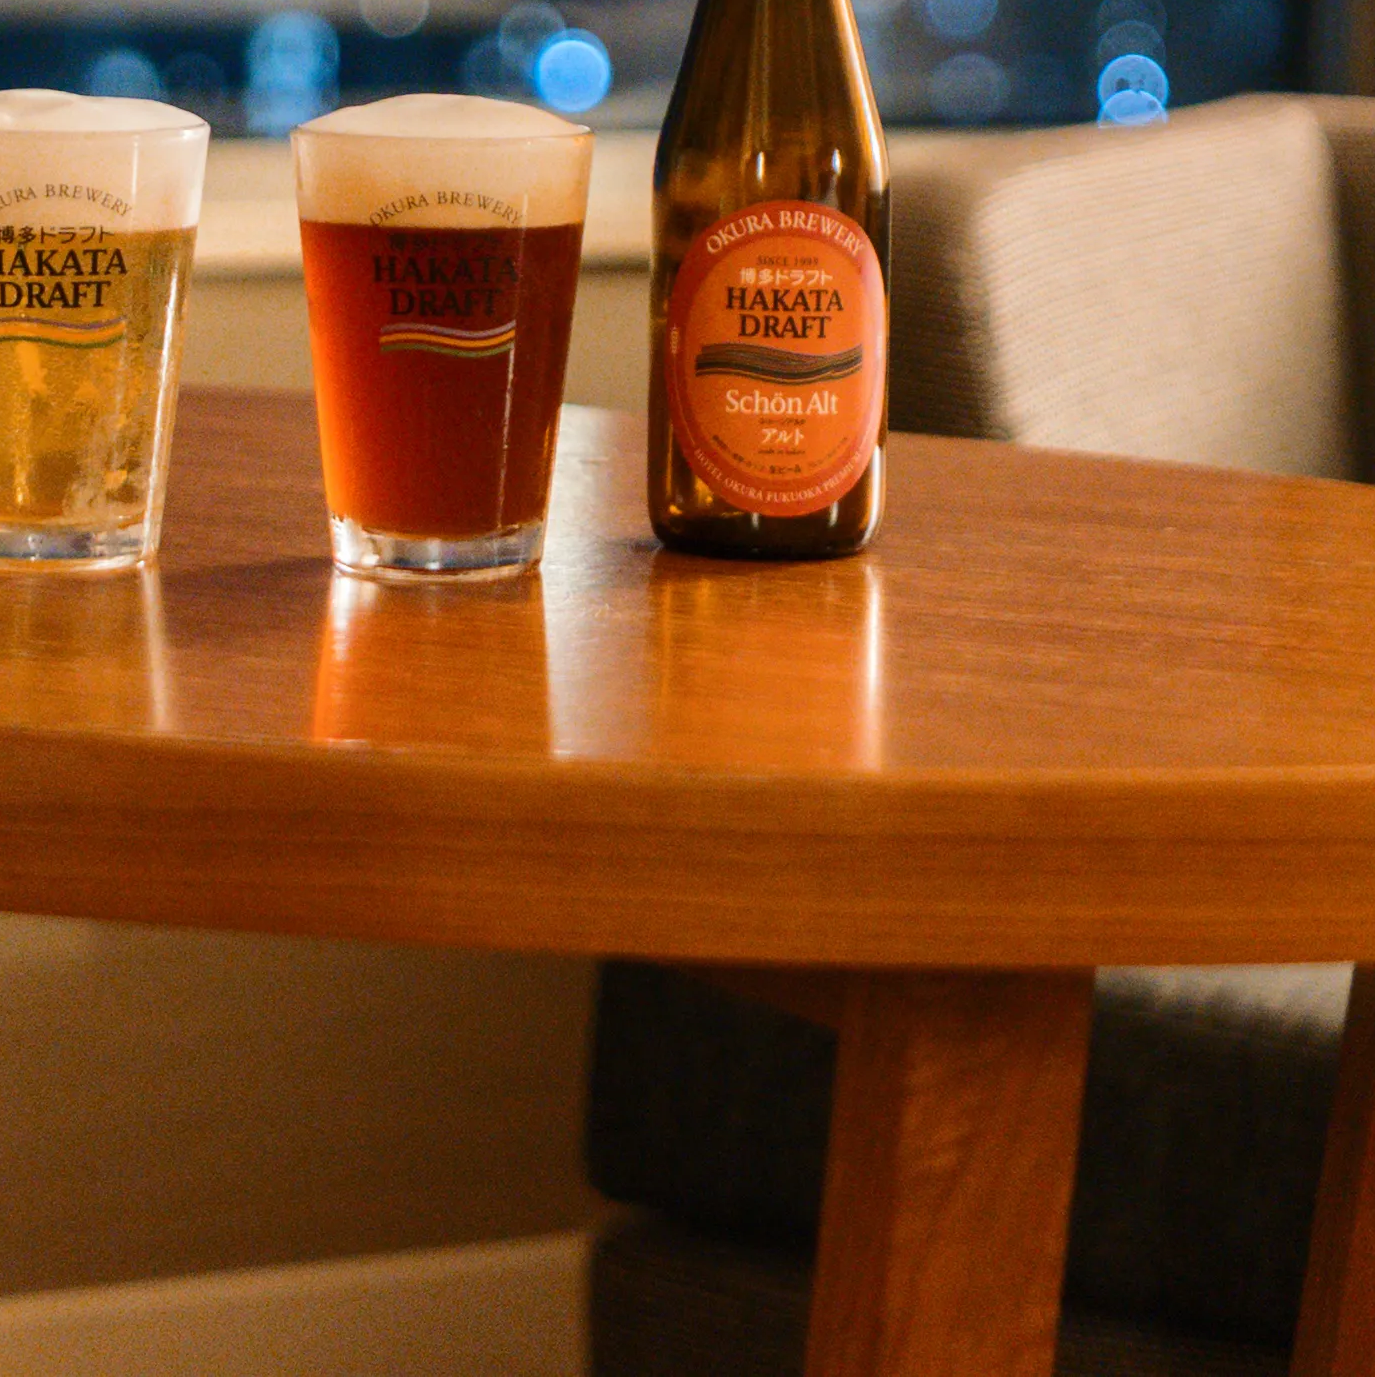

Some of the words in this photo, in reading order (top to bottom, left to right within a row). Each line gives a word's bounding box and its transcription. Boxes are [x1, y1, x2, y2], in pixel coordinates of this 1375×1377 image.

[45, 183, 132, 217] BREWERY
[370, 194, 430, 225] OKURA
[437, 191, 523, 225] BREWERY
[706, 212, 774, 254] OKURA
[779, 210, 864, 257] BREWERY
[373, 256, 519, 284] HAKATA
[740, 267, 833, 286] 博多ドラフト
[388, 288, 502, 317] DRAFT
[726, 287, 843, 312] HAKATA
[738, 315, 831, 339] DRAFT
[725, 389, 806, 415] Schön
[807, 390, 839, 415] Alt
[761, 428, 804, 446] アルト
[694, 448, 722, 480] HOTEL
[723, 478, 763, 502] OKURA
[765, 487, 822, 503] FUKUOKA
